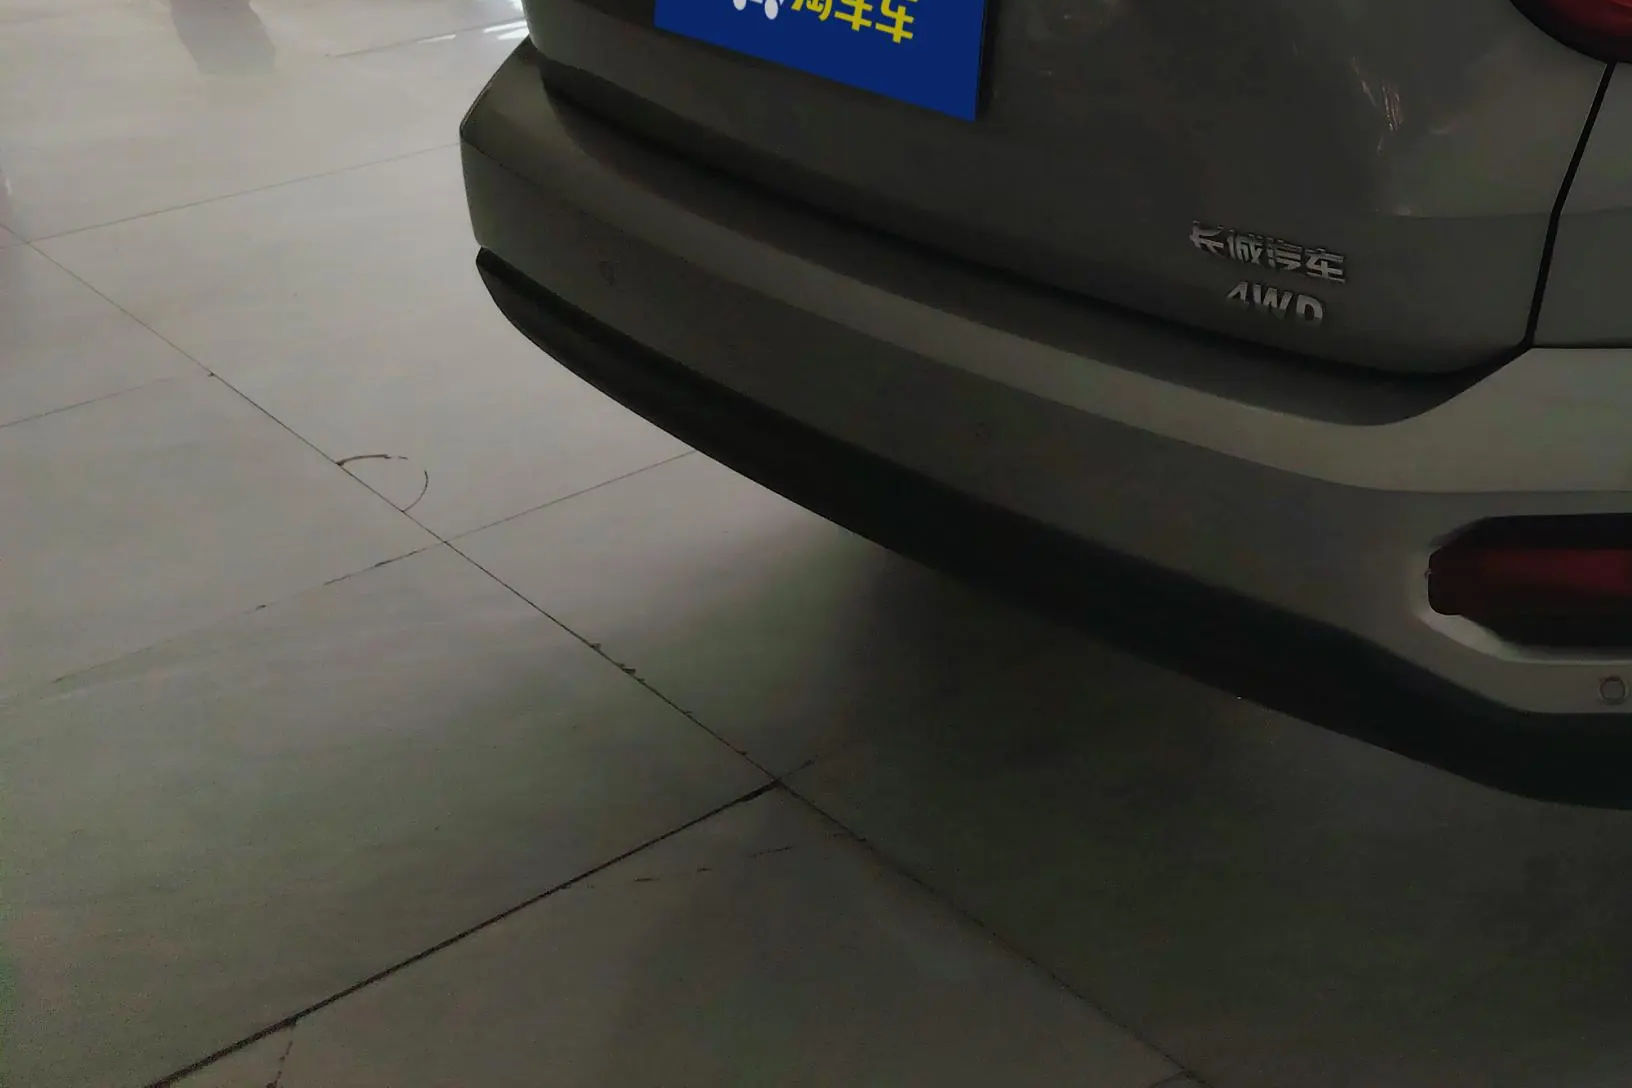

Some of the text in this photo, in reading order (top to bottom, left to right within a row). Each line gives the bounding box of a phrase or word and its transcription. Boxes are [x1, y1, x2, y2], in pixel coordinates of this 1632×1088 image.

[1189, 220, 1346, 283] 长城汽车
[1226, 281, 1325, 326] 4WD
